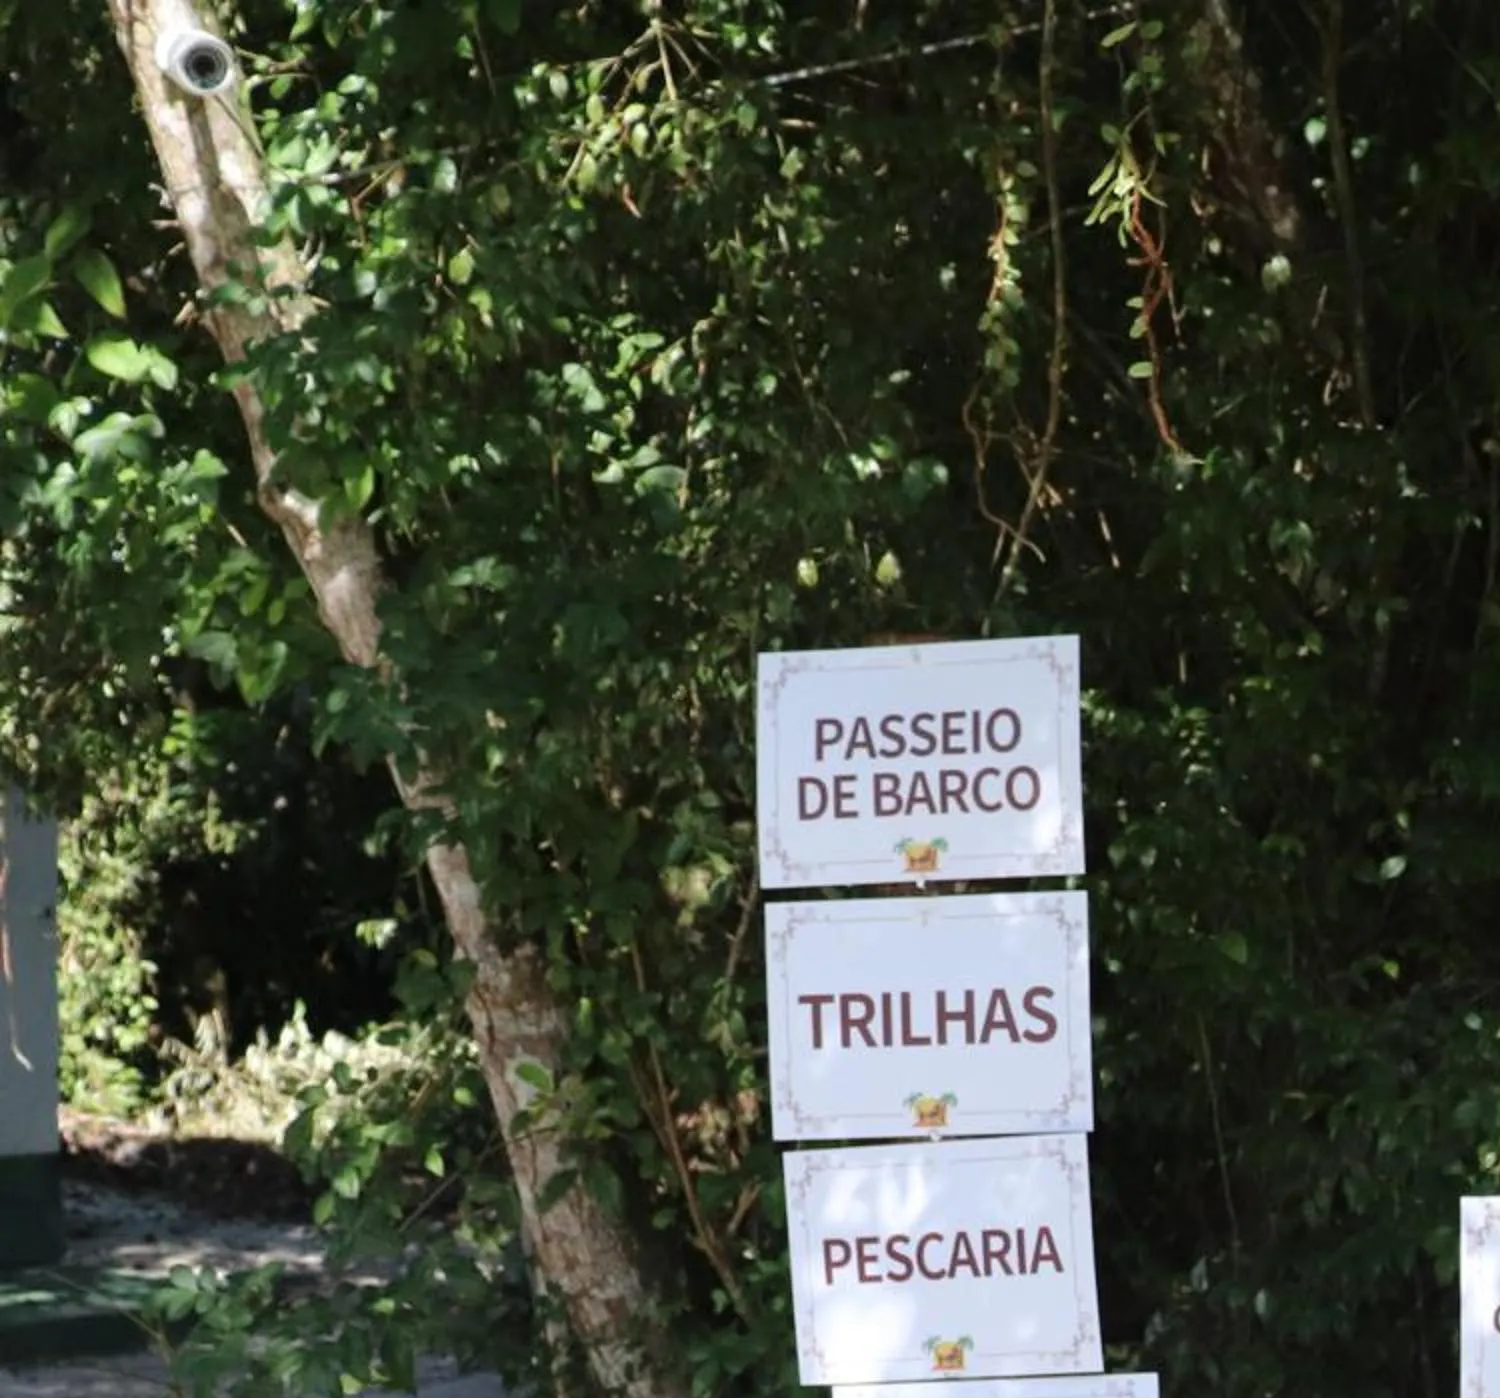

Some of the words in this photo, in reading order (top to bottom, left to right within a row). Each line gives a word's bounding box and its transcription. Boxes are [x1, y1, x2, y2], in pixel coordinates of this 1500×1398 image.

[815, 707, 1022, 762] PASSEIO
[797, 774, 860, 821] DE
[873, 765, 1041, 817] BARCO
[797, 986, 1057, 1049] TRILHAS
[823, 1226, 1064, 1285] PESCARIA
